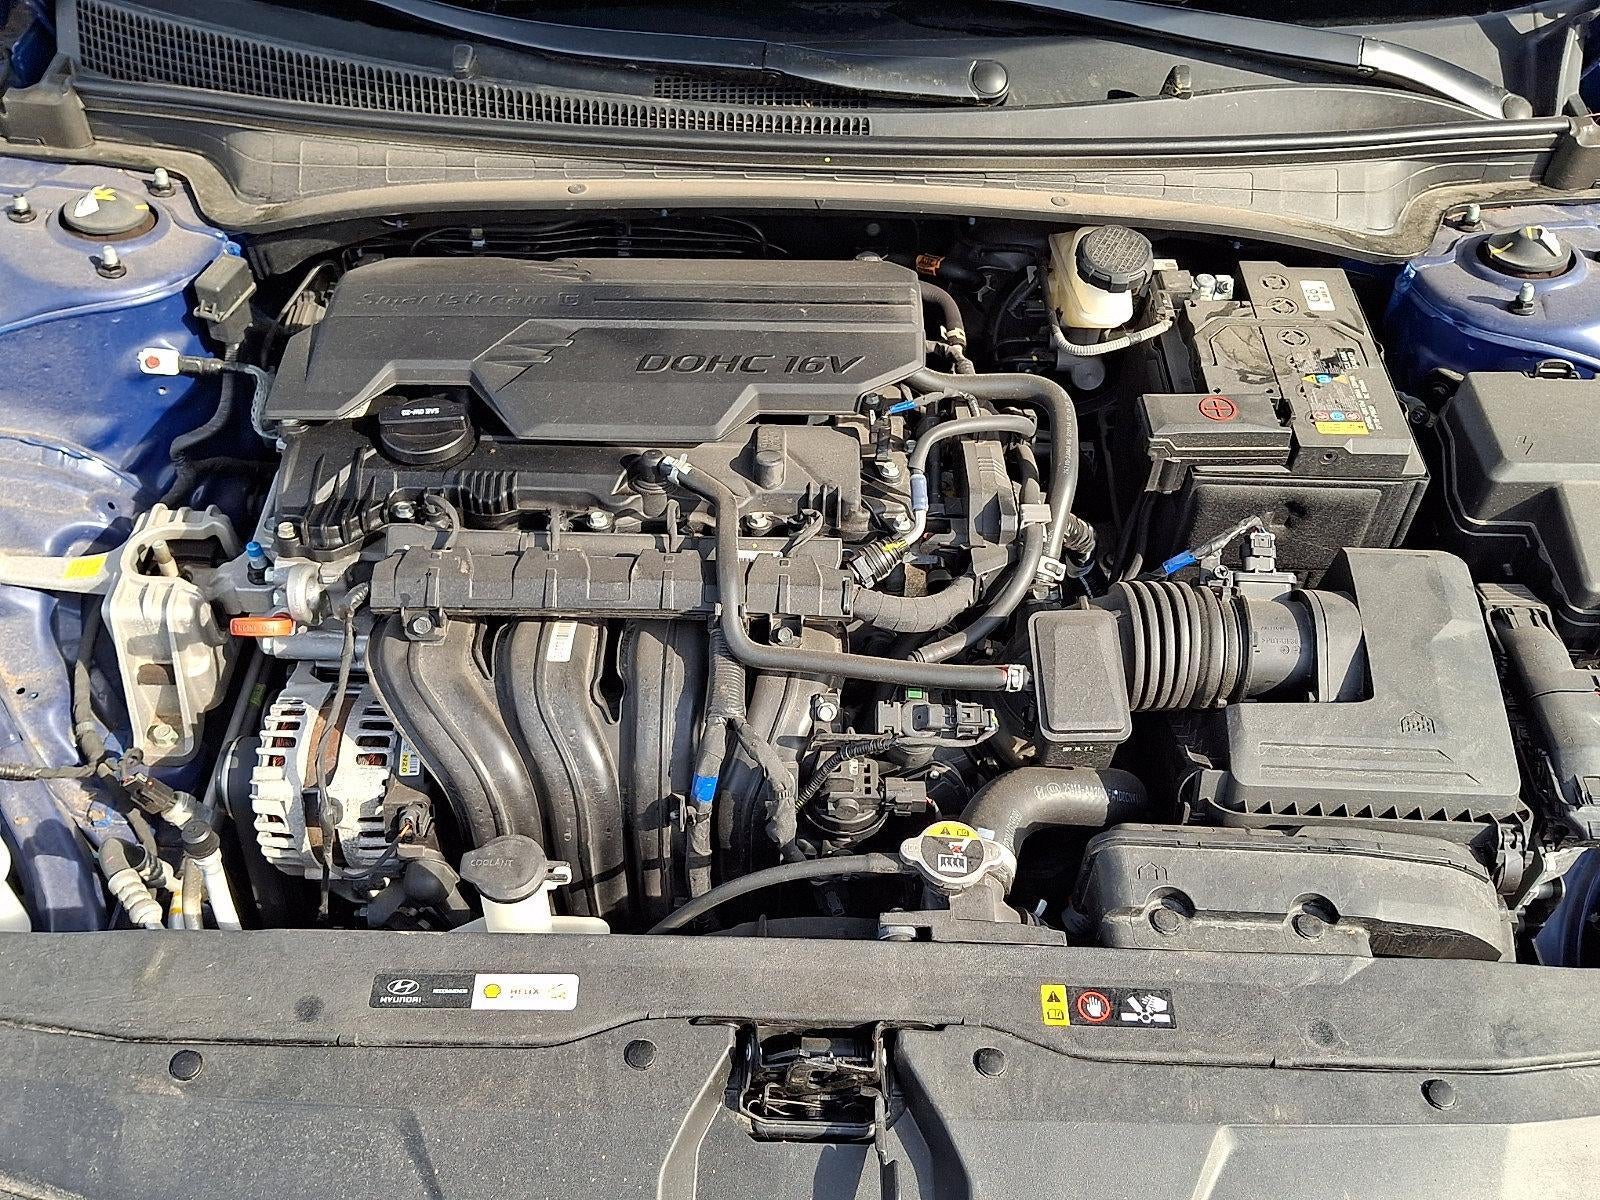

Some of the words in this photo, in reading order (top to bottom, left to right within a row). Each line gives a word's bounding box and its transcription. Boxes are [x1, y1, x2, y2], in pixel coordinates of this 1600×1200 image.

[635, 353, 776, 374] DOHC
[783, 354, 866, 375] 16V
[470, 858, 514, 867] COOLANT
[379, 996, 422, 1004] HYUNDAI
